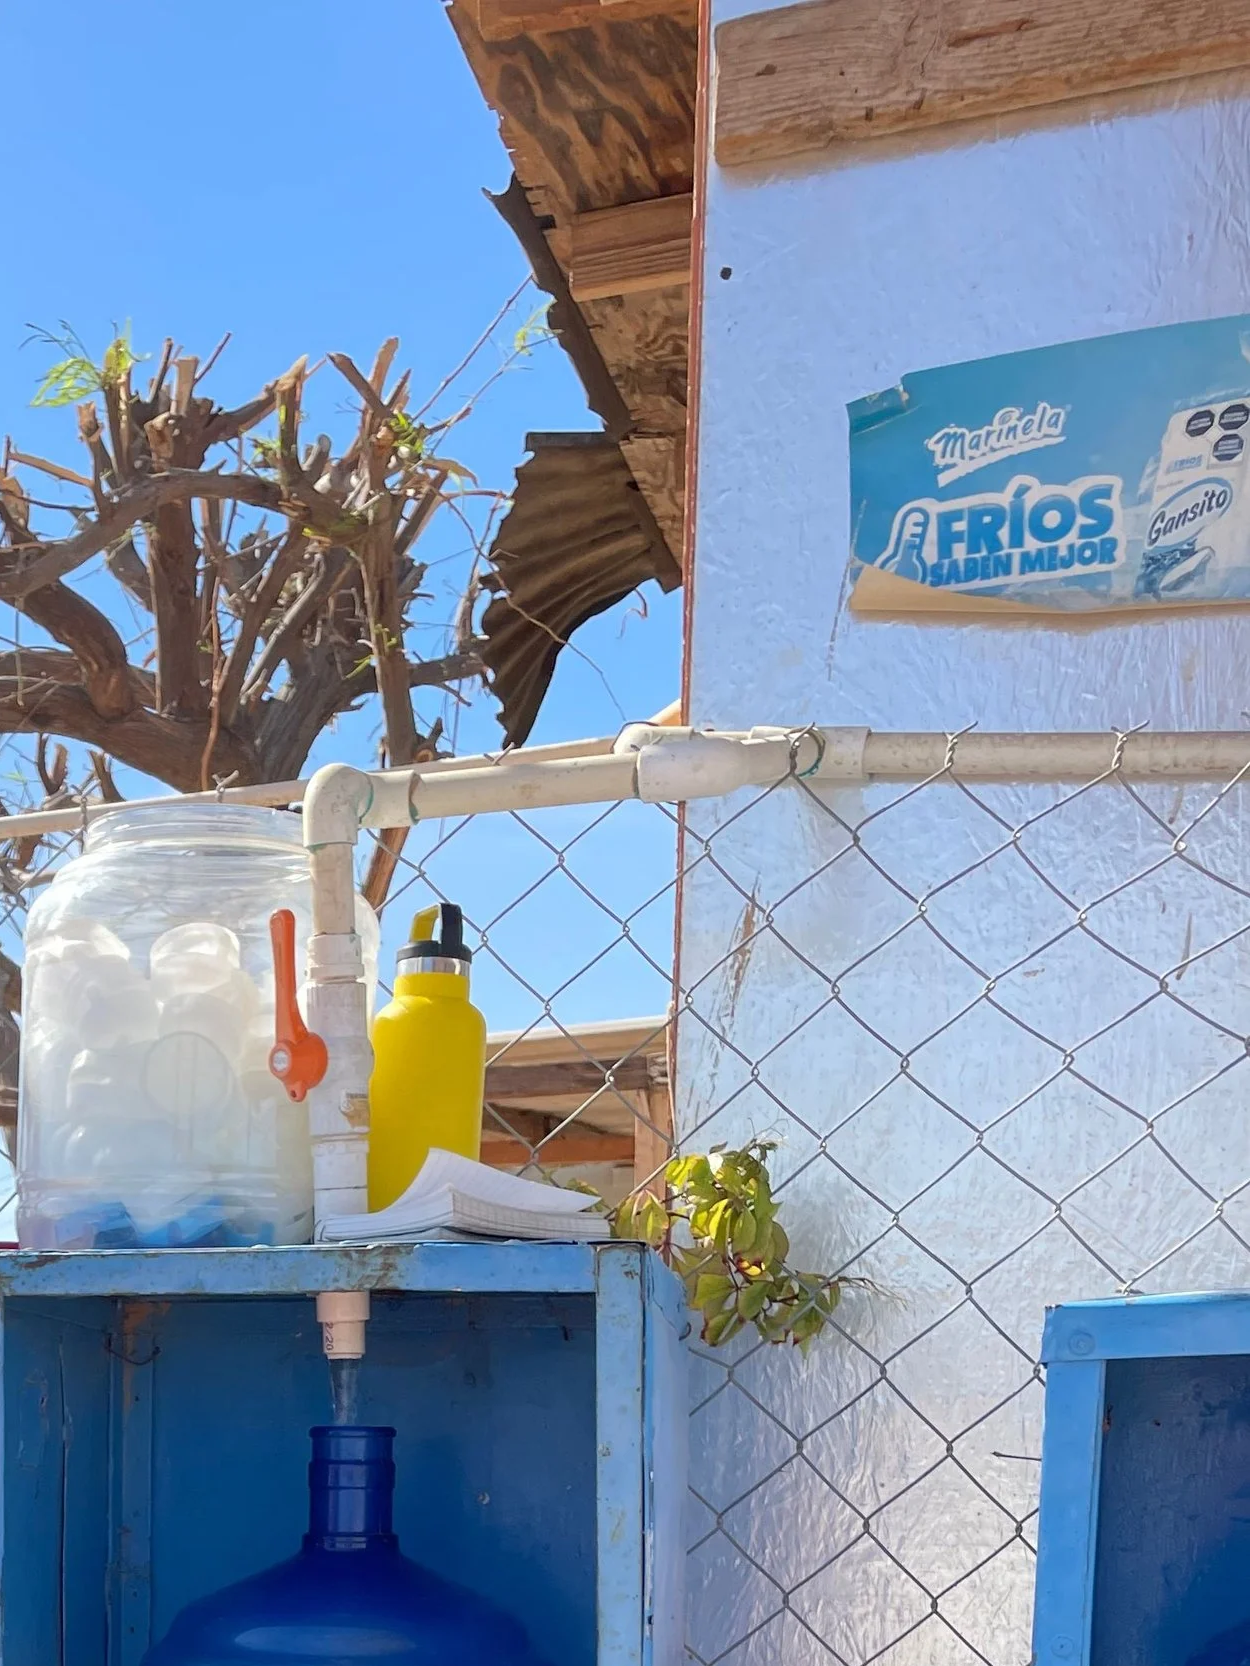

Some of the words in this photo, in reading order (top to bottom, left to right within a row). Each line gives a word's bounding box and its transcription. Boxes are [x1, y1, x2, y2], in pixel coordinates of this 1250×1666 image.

[929, 402, 1063, 464] Marinela
[936, 483, 1115, 561] FRÍOS
[1147, 488, 1228, 547] Gansito
[929, 551, 1012, 588] SABEN
[1019, 537, 1117, 575] MEJOR
